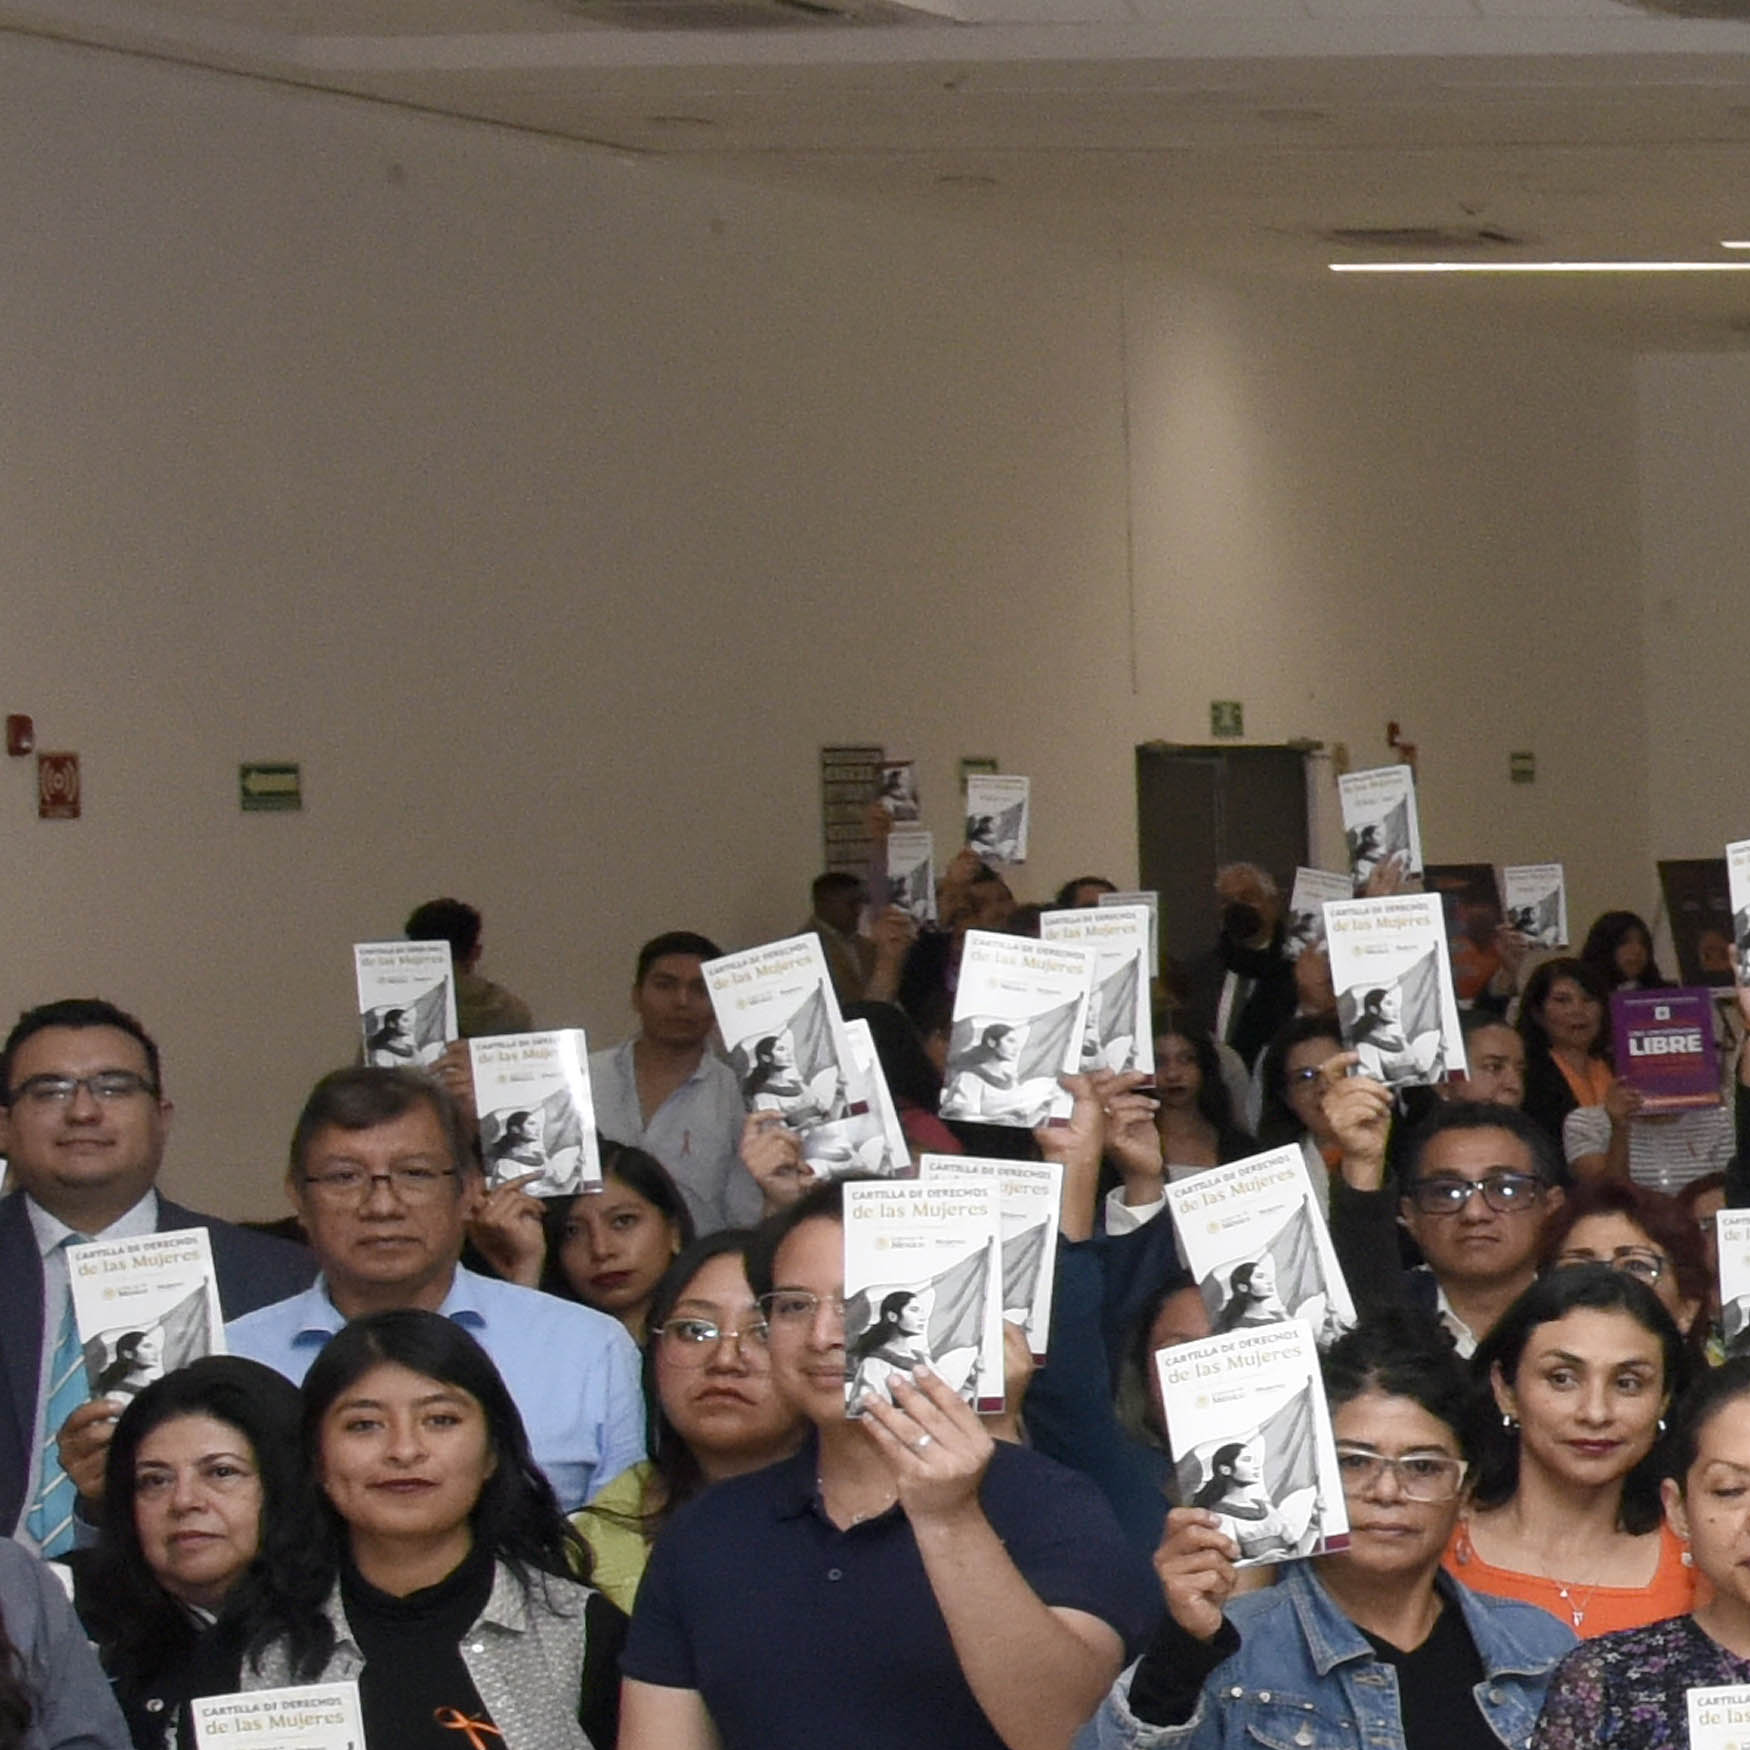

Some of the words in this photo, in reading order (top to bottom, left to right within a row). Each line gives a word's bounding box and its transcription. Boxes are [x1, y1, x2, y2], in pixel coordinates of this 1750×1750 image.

[713, 976, 730, 990] de
[731, 972, 752, 985] las
[753, 954, 815, 979] Mujeres
[1629, 1033, 1702, 1056] LIBRE
[1002, 1179, 1050, 1197] ujeres
[1172, 1176, 1222, 1200] CARTILLA
[1223, 1171, 1236, 1183] DE
[1237, 1153, 1290, 1179] DERECHOS
[852, 1190, 905, 1202] CARTILLA
[909, 1190, 922, 1200] DE
[926, 1187, 989, 1199] DERECHOS
[1178, 1198, 1200, 1214] de
[1201, 1191, 1226, 1207] las
[1229, 1167, 1294, 1197] Mujeres
[852, 1203, 874, 1218] de
[880, 1202, 904, 1218] las
[911, 1202, 990, 1220] Mujeres
[1723, 1228, 1742, 1241] de
[75, 1246, 124, 1262] CARTILLA
[127, 1244, 140, 1254] DE
[78, 1262, 98, 1276] de
[102, 1259, 126, 1273] las
[131, 1249, 201, 1269] Mujeres
[1165, 1346, 1218, 1368] CARTILLA
[1220, 1343, 1235, 1355] DE
[1237, 1327, 1302, 1351] DERECHOS
[1169, 1367, 1191, 1383] de
[1194, 1363, 1220, 1378] las
[1225, 1344, 1304, 1371] Mujeres
[203, 1704, 260, 1718] CARTILLA
[262, 1702, 277, 1713] DE
[280, 1696, 344, 1711] DERECHOS
[1698, 1710, 1721, 1726] de
[205, 1719, 229, 1735] de
[234, 1717, 261, 1732] las
[267, 1712, 346, 1730] Mujeres
